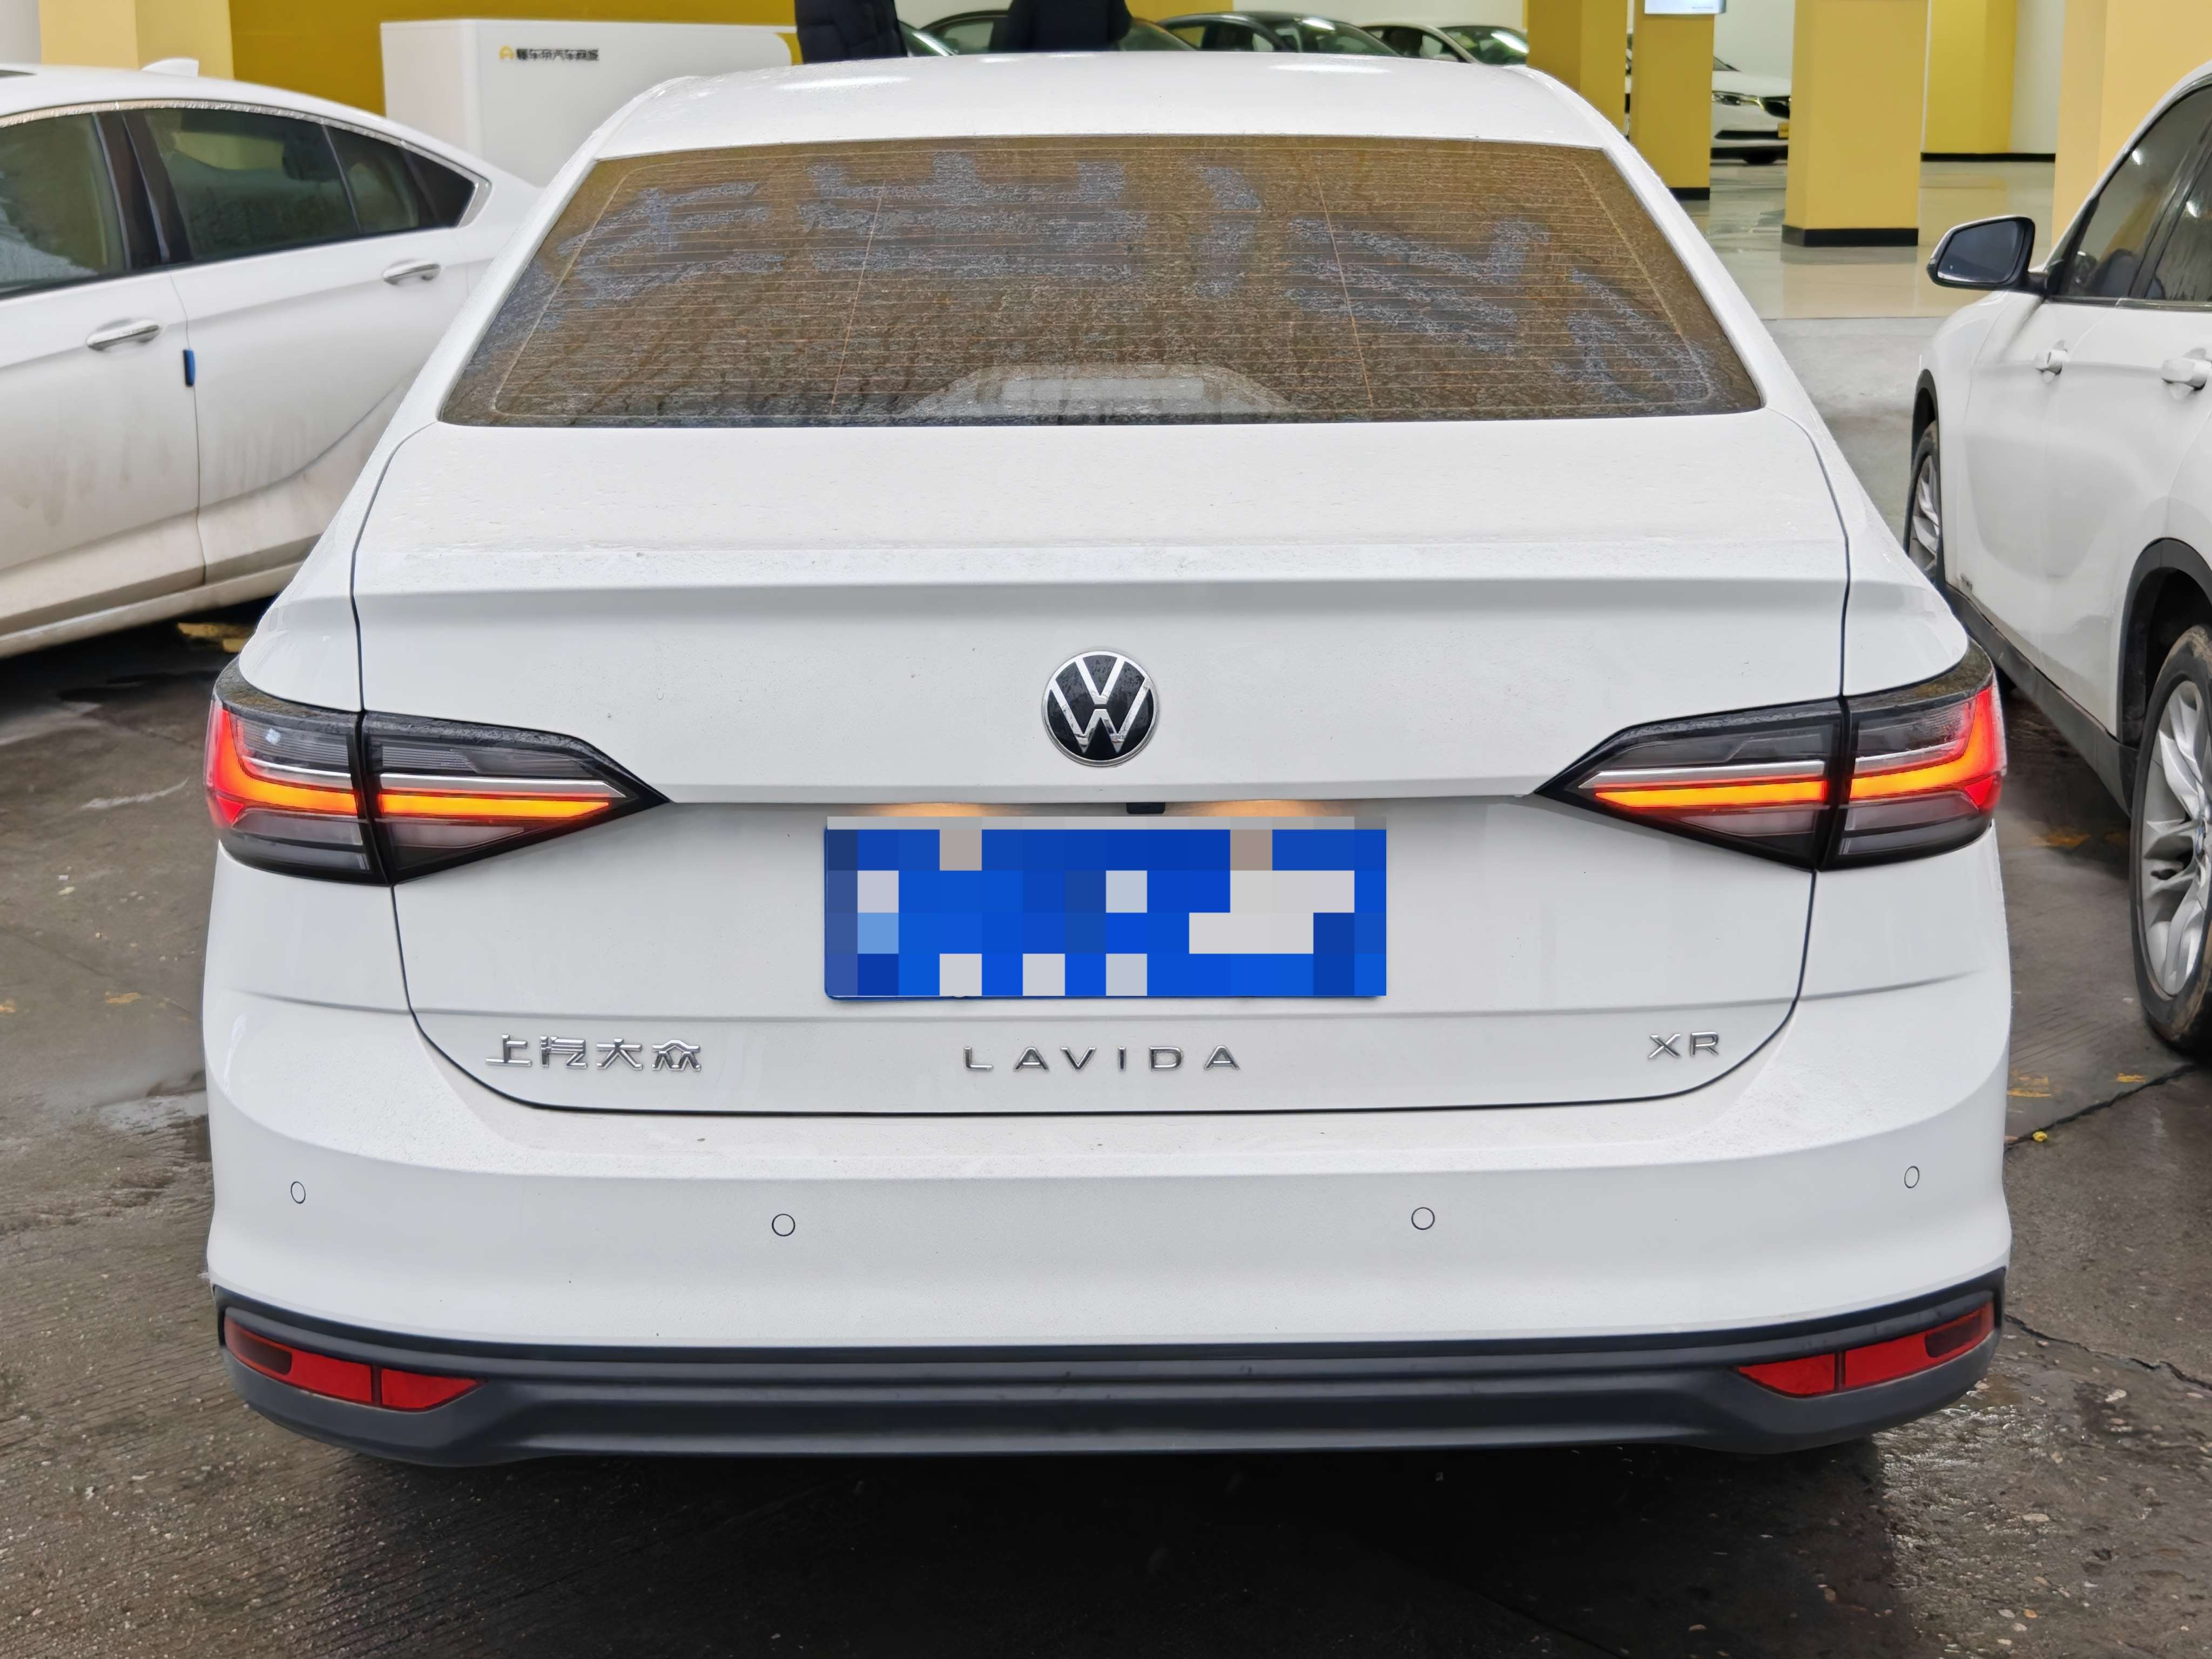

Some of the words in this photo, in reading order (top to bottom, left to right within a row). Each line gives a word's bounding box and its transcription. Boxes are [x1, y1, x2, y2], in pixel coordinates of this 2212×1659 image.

[1047, 652, 1154, 756] VW
[486, 1034, 701, 1071] 上汽大众
[963, 1045, 1240, 1071] LAVIDA
[1648, 1031, 1719, 1058] XR
